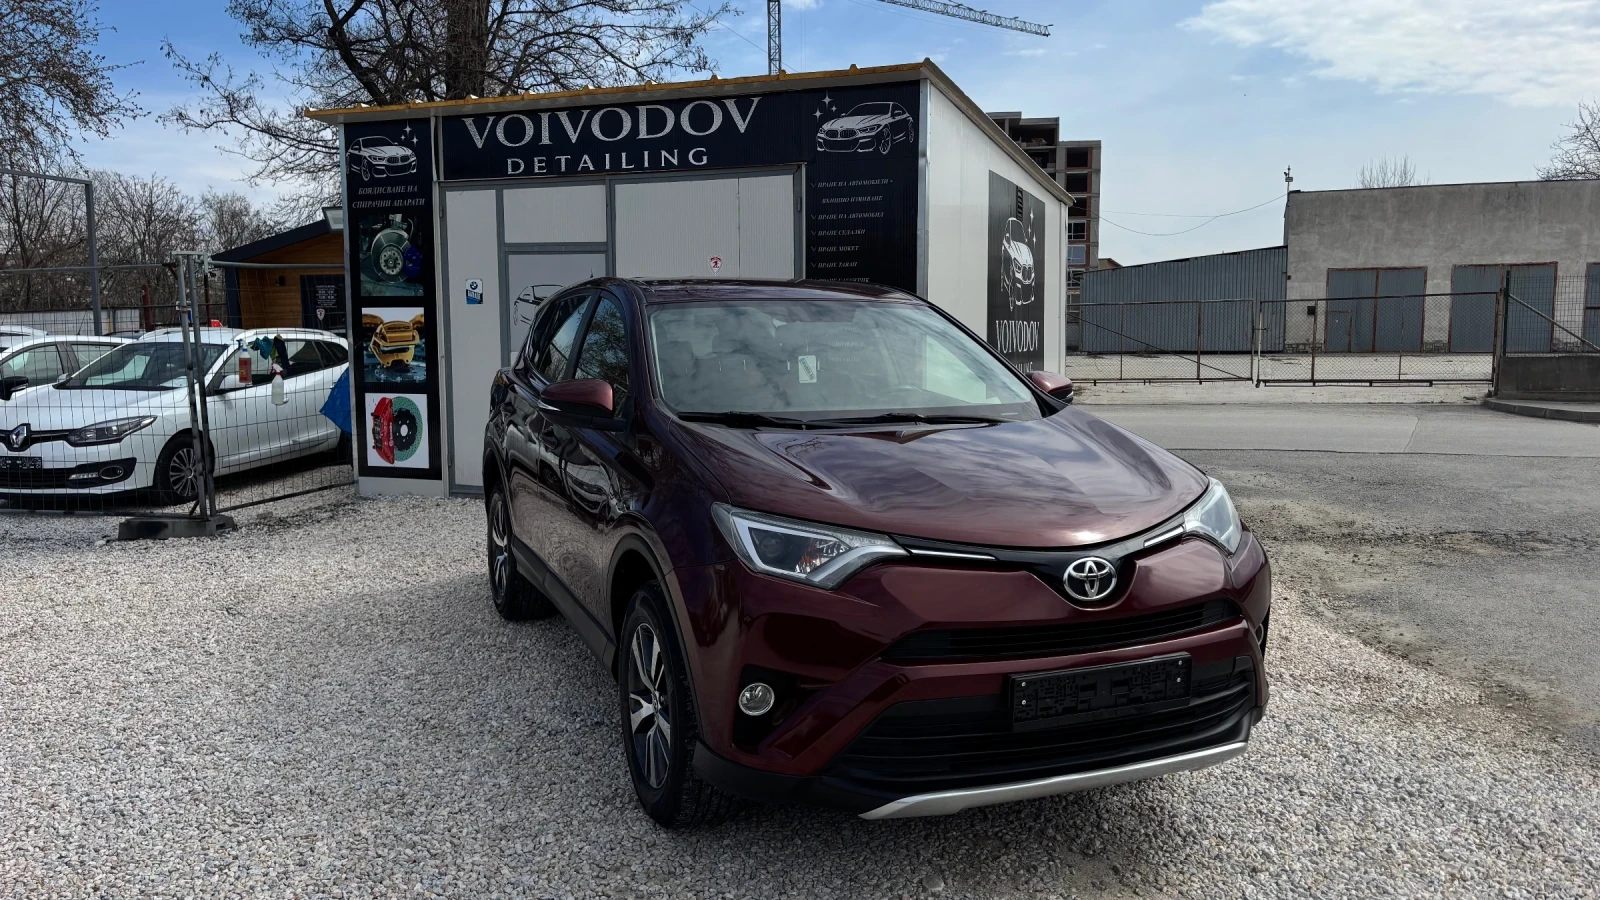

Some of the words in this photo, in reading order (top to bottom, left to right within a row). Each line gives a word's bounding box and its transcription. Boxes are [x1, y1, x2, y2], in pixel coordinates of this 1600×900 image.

[461, 97, 762, 149] VOIVODOV
[506, 147, 709, 175] DETAILING
[352, 200, 392, 208] СПИРАЧНИ
[392, 198, 425, 207] АПАРАТИ
[358, 185, 406, 195] БОЯДИСВАНЕ
[407, 185, 418, 193] НА
[995, 320, 1040, 354] VOIVODOV
